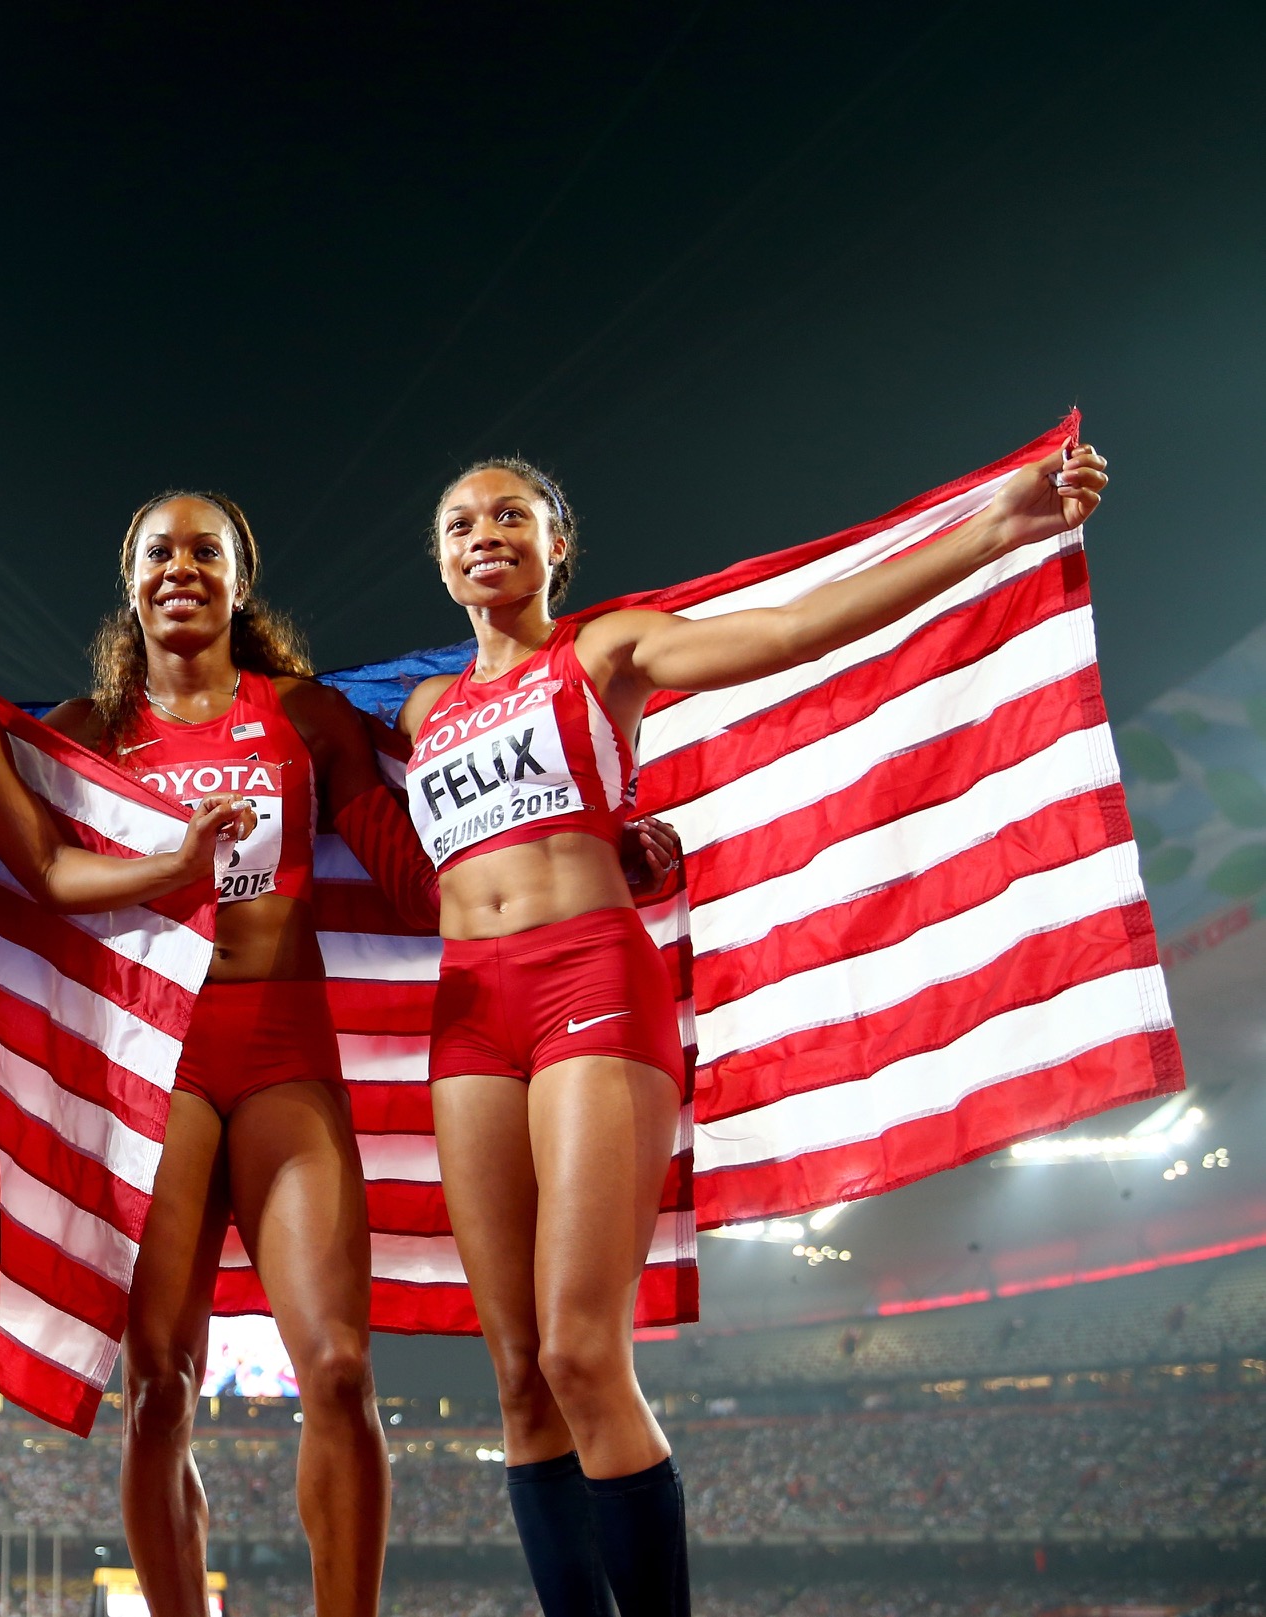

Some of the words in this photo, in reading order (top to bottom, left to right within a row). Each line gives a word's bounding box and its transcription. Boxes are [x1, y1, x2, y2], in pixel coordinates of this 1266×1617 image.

[417, 688, 549, 763] TOYOTA
[140, 766, 276, 795] OYOTA
[421, 727, 547, 822] FELIX
[433, 804, 505, 861] BEIJING
[511, 786, 570, 823] 2015
[220, 871, 273, 899] 2015
